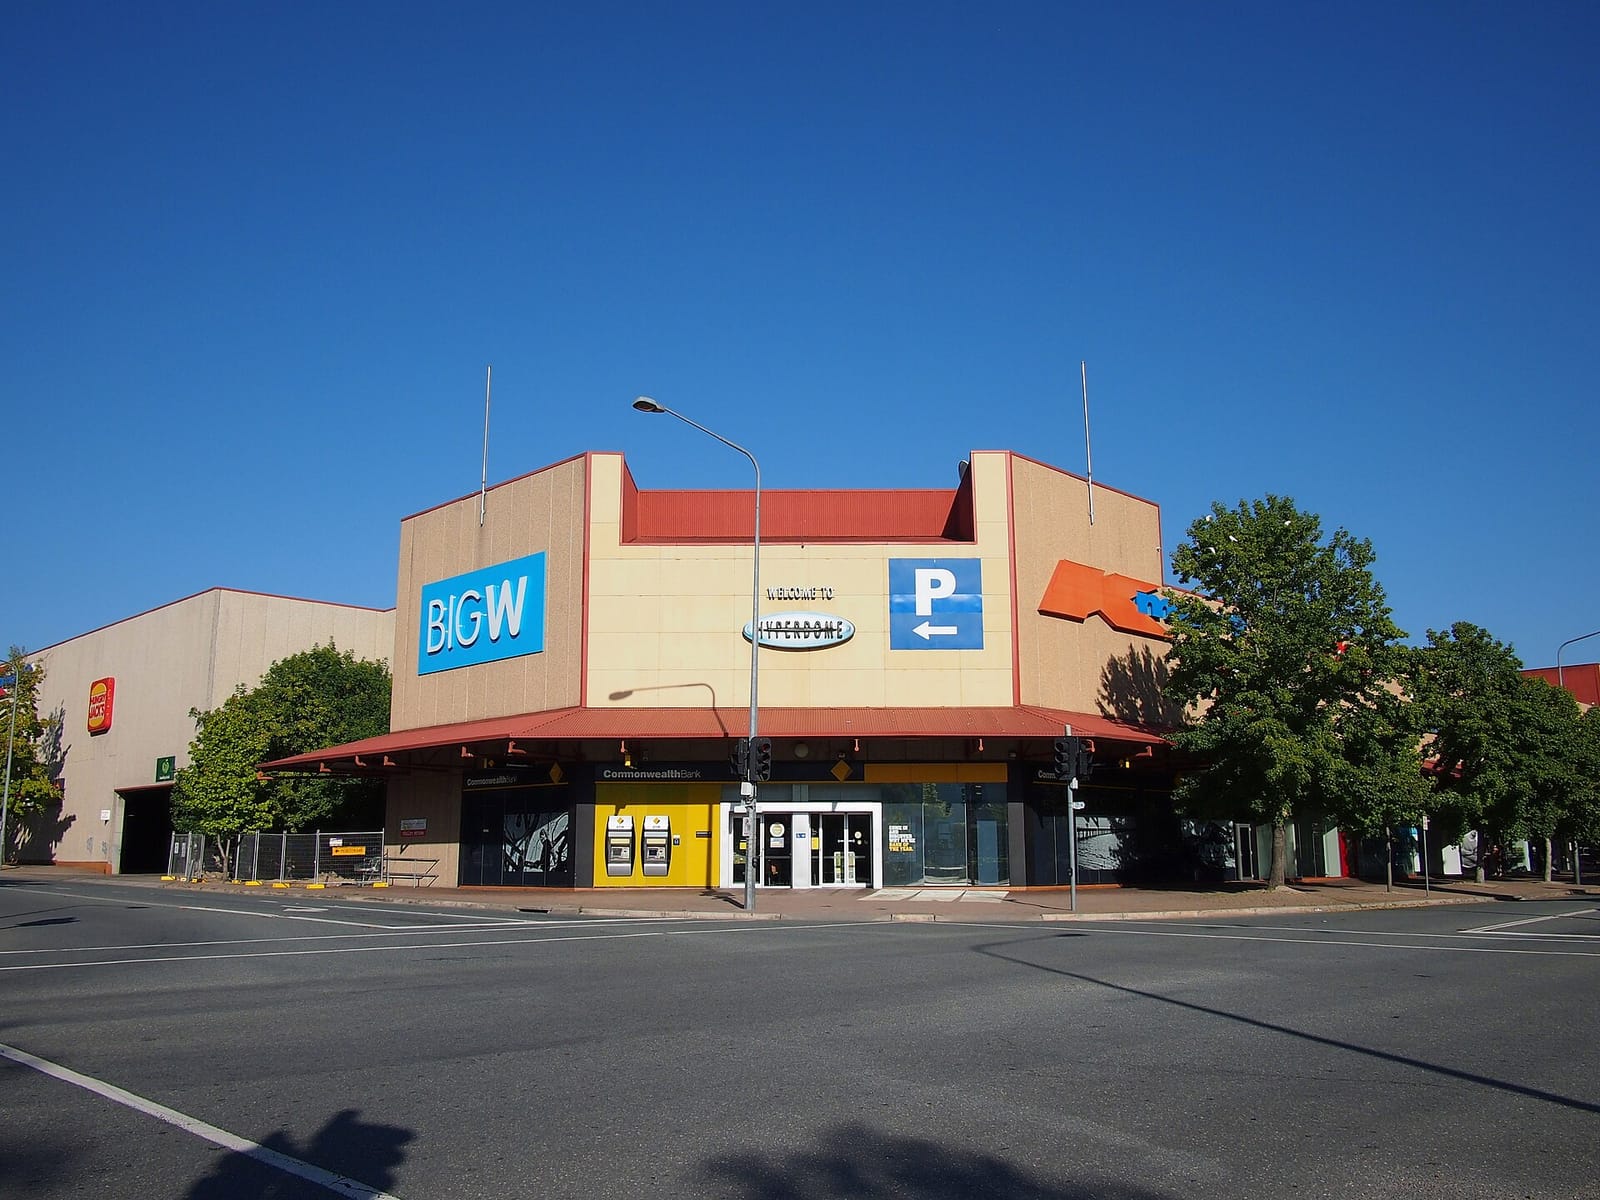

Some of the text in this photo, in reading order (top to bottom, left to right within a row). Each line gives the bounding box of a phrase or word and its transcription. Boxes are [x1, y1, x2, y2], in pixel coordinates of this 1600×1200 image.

[767, 587, 833, 600] WELCOME TO
[915, 569, 956, 616] P
